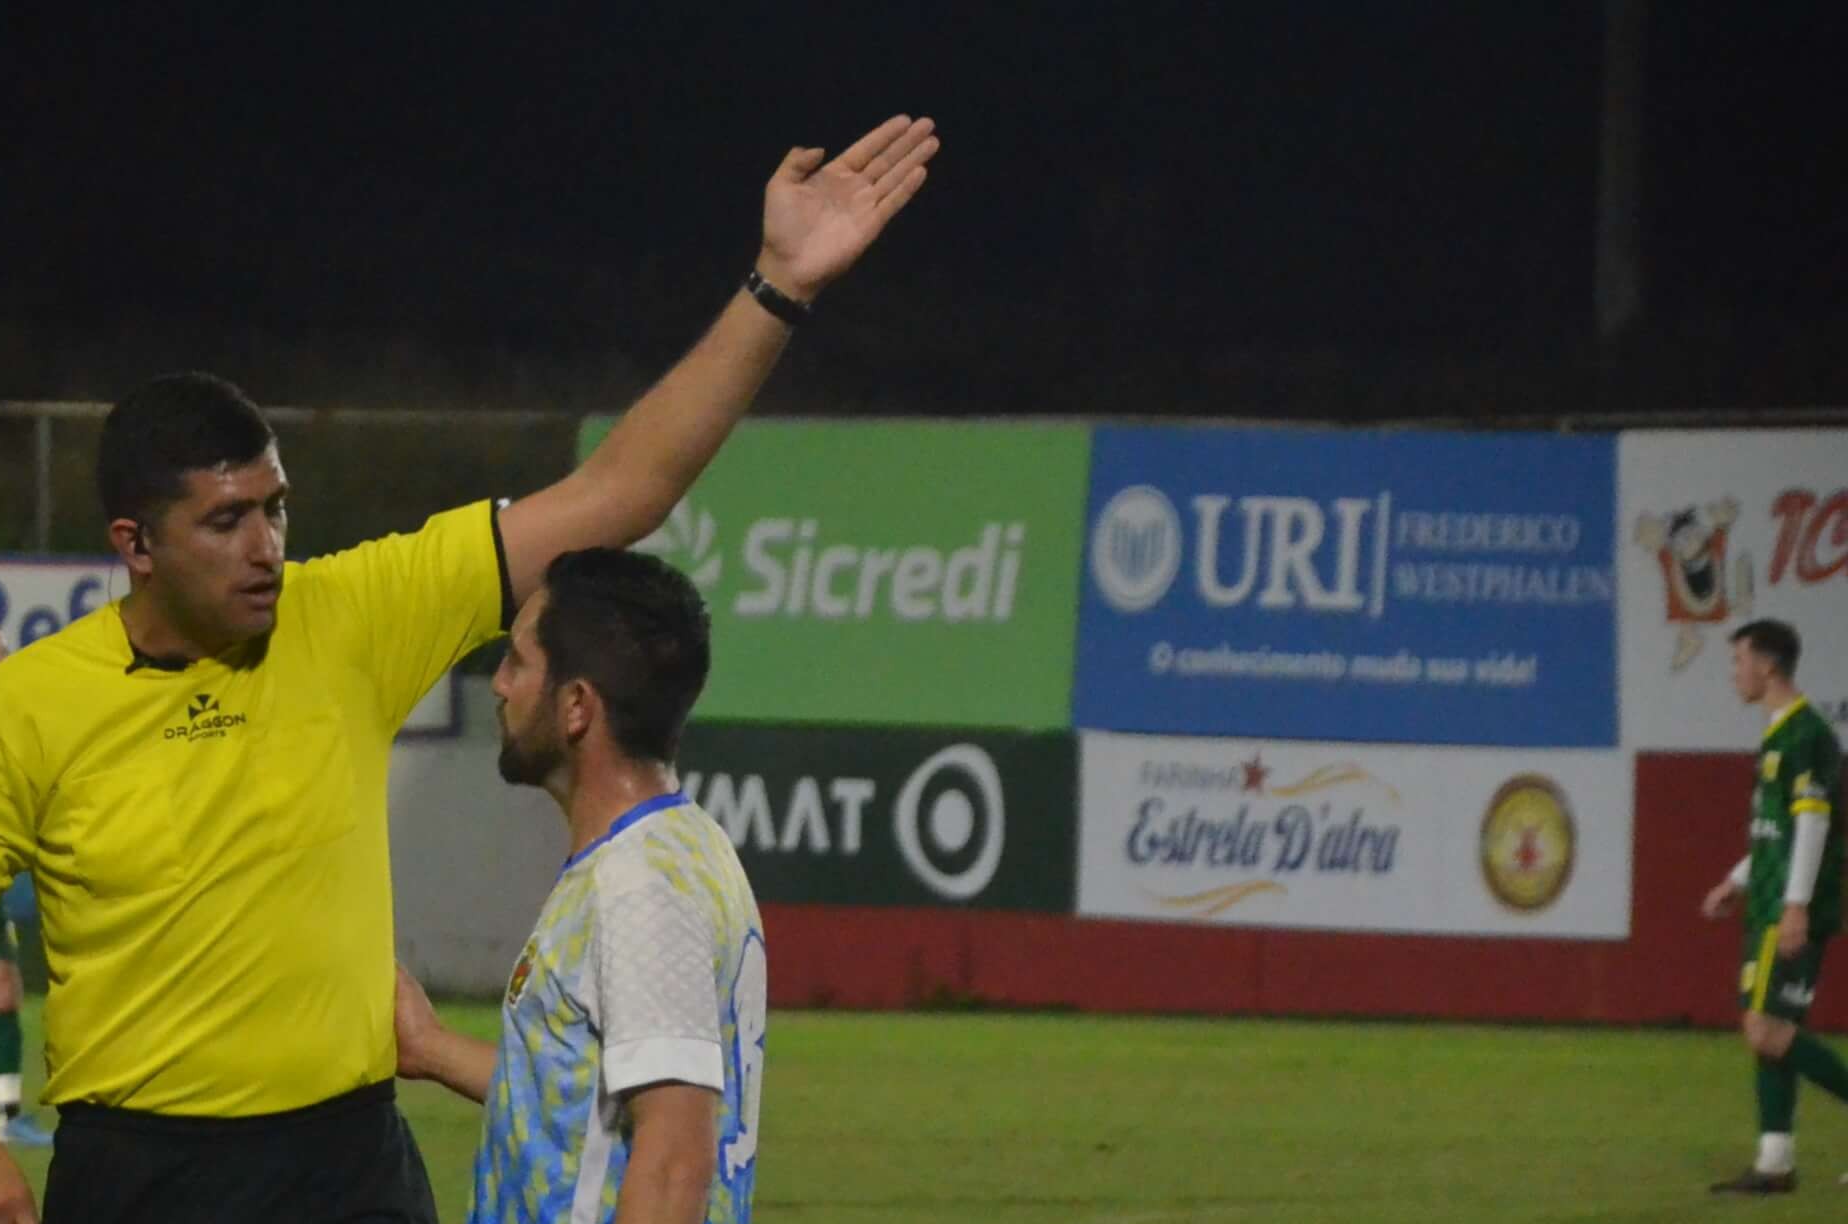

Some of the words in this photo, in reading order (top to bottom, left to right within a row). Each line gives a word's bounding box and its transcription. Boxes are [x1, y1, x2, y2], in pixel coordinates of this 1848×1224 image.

[1192, 495, 1370, 610] URI
[1399, 511, 1580, 550] FREDERICO
[734, 518, 1023, 620] Sicredi
[1392, 561, 1612, 602] WESTPHALEN
[1150, 641, 1173, 673] O
[1127, 798, 1266, 866] Estrela
